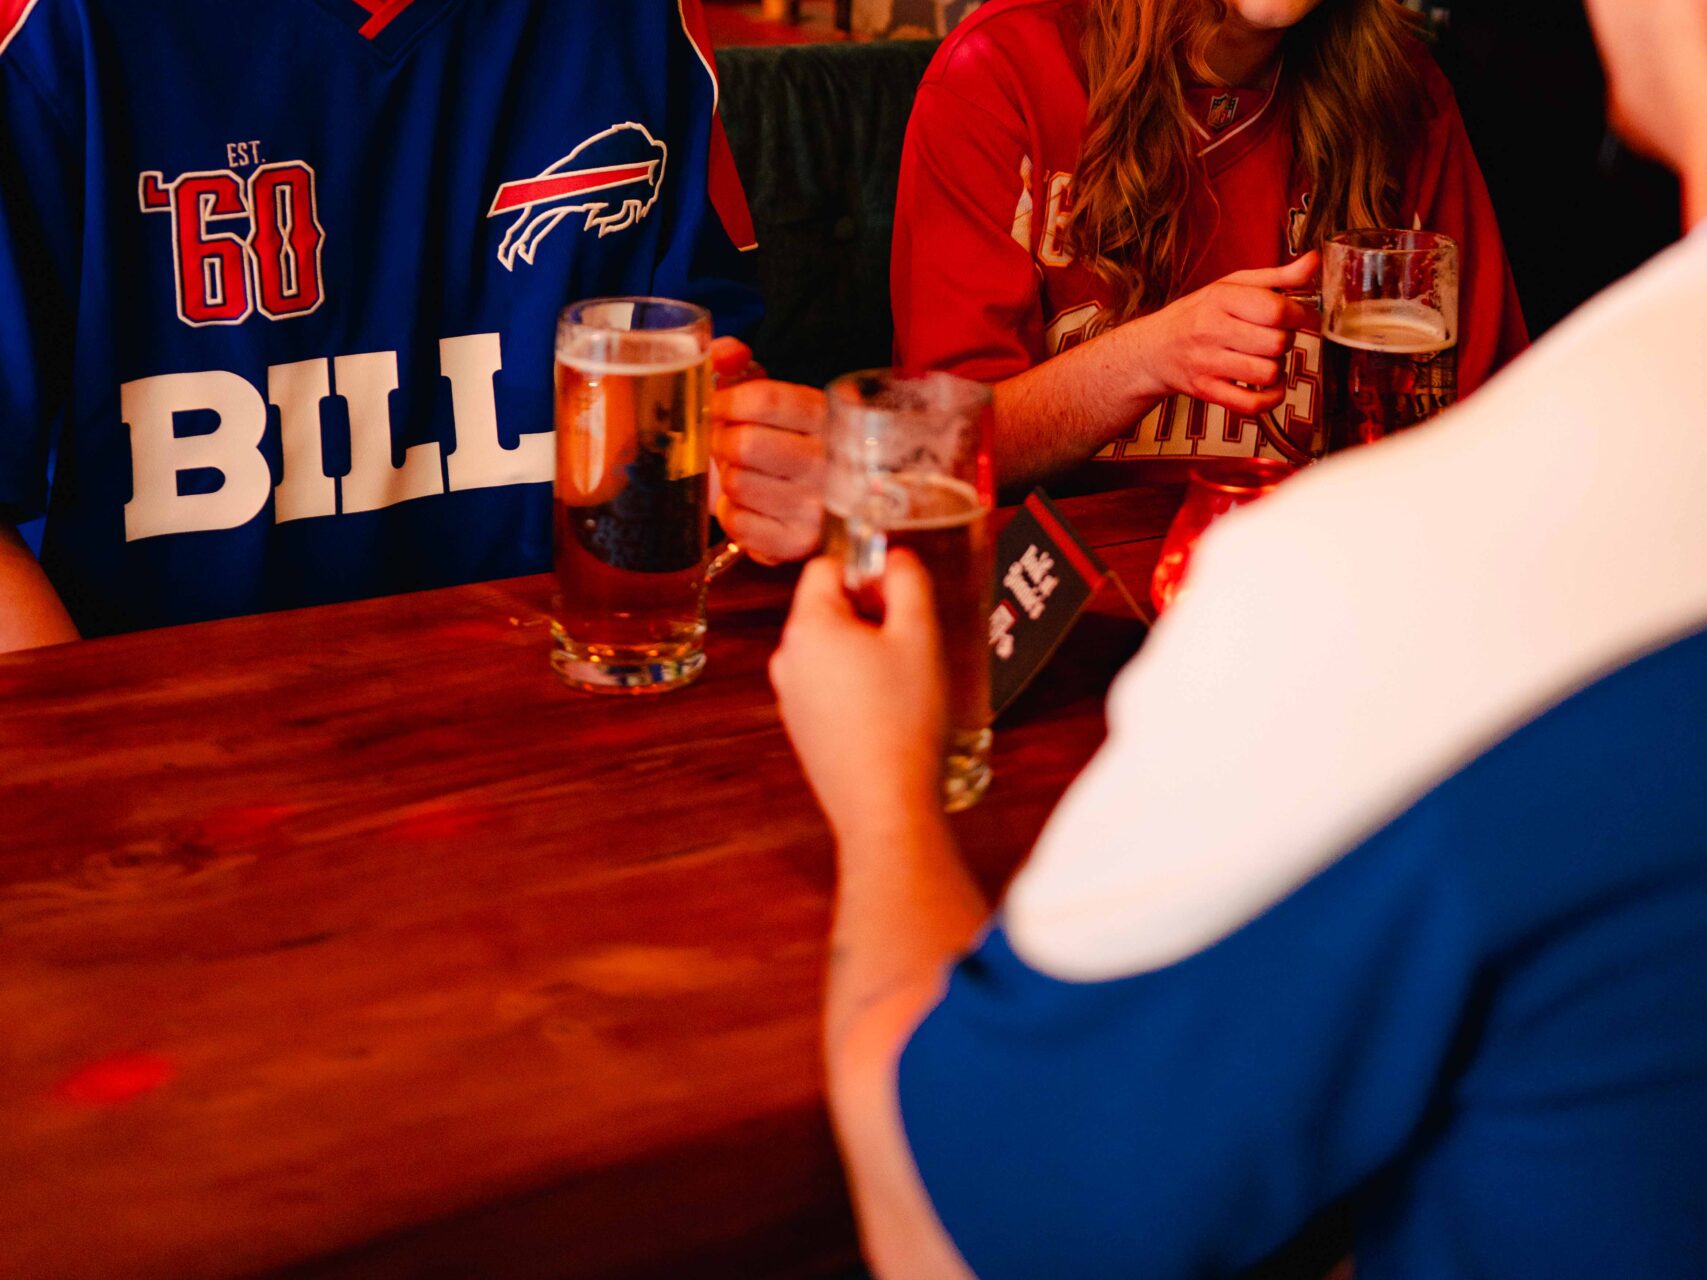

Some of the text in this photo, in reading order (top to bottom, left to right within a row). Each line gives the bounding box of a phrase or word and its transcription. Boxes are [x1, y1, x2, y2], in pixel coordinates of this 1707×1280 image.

[226, 140, 267, 168] EST.
[138, 159, 326, 328] '60
[120, 302, 635, 543] BILL
